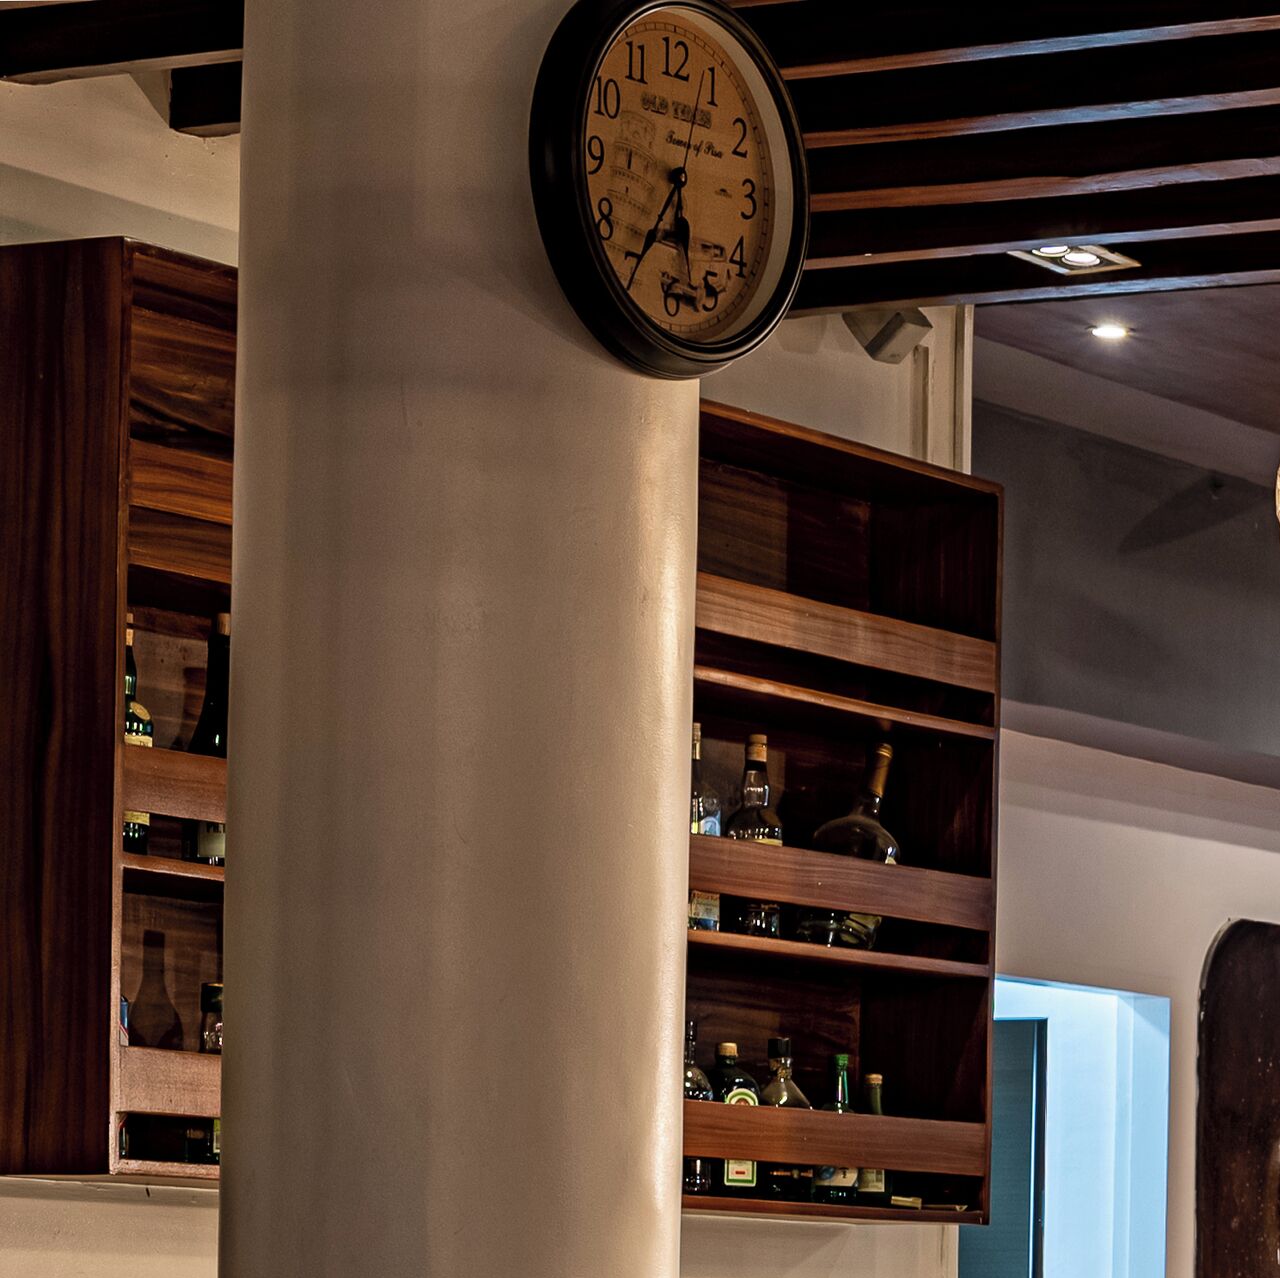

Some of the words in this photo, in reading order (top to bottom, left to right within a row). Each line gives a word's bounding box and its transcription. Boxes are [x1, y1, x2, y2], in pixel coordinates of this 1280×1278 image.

[625, 41, 648, 85] 11
[661, 36, 690, 82] 12
[593, 75, 621, 120] 10
[640, 91, 669, 116] OLD
[706, 66, 719, 107] 1
[587, 135, 605, 175] 9
[692, 137, 705, 157] of
[703, 140, 725, 159] Pisa
[731, 117, 749, 159] 2
[597, 197, 614, 241] 8
[740, 178, 758, 220] 3
[728, 235, 748, 279] 4
[663, 276, 681, 317] 6
[701, 270, 719, 312] 5
